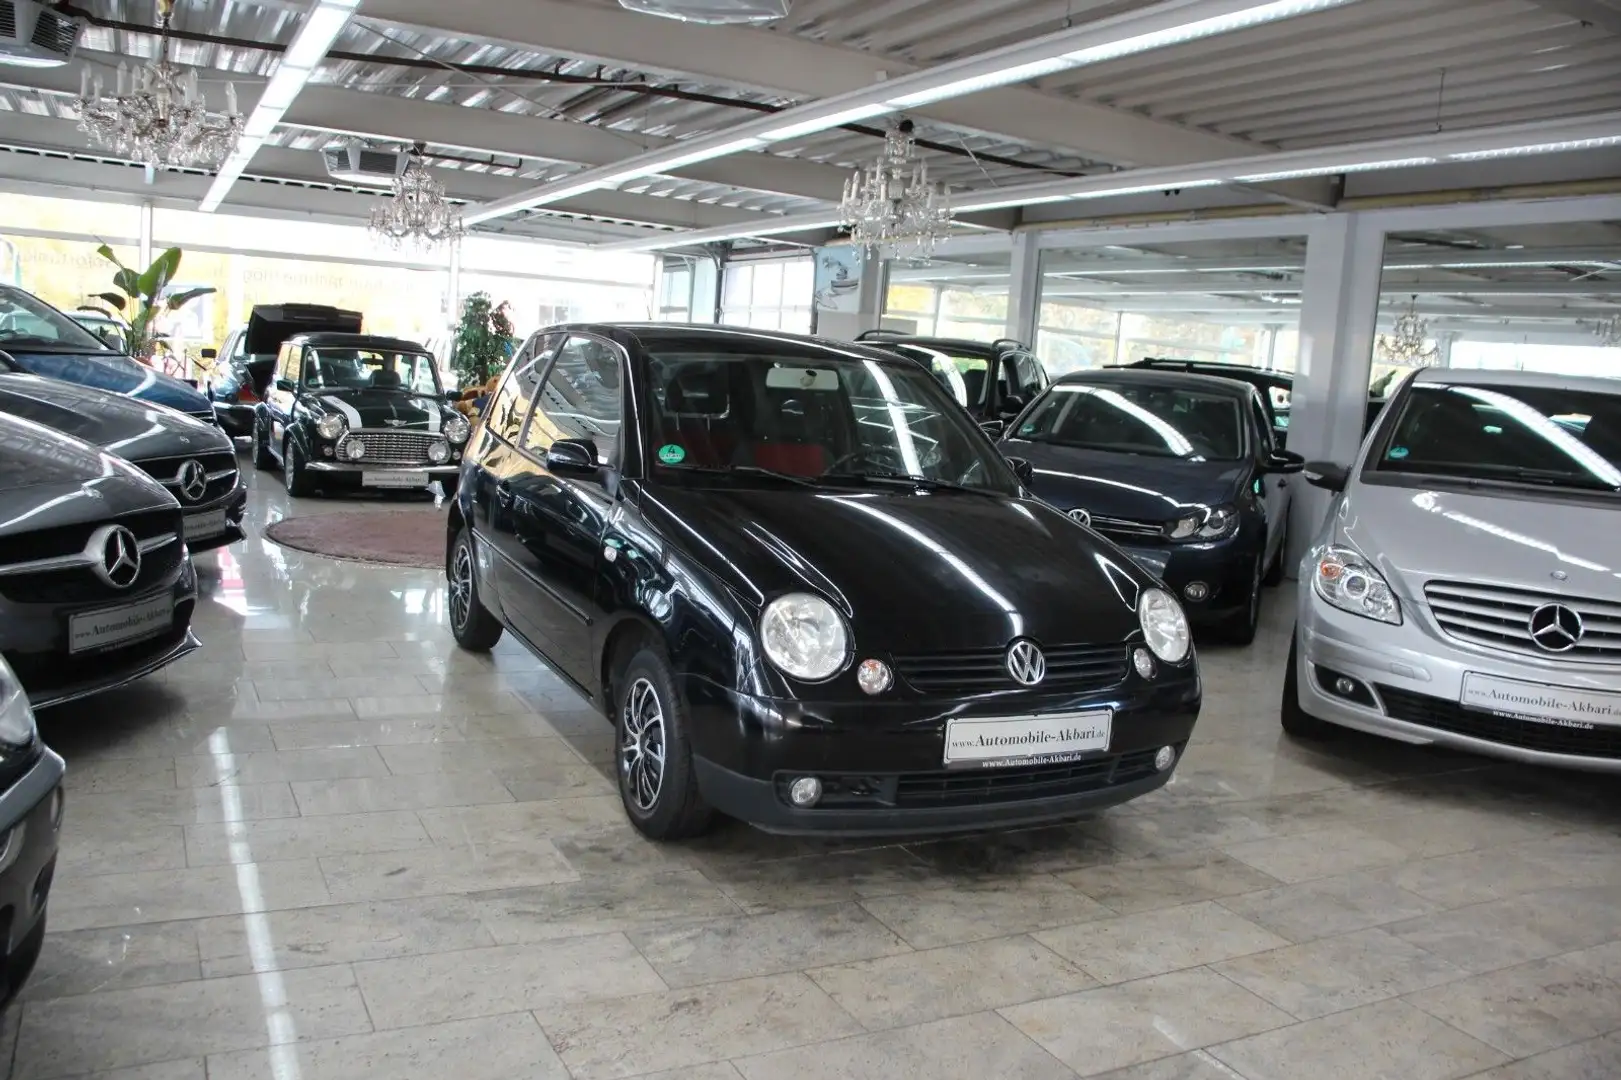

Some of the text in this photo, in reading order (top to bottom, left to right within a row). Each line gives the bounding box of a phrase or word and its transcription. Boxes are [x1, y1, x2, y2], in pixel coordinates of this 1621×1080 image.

[1492, 709, 1594, 730] www.Automobile-Akbari.de
[952, 726, 1105, 748] www.Automobile-Akbari.de
[982, 753, 1081, 768] www.Automobile-Akbari.de
